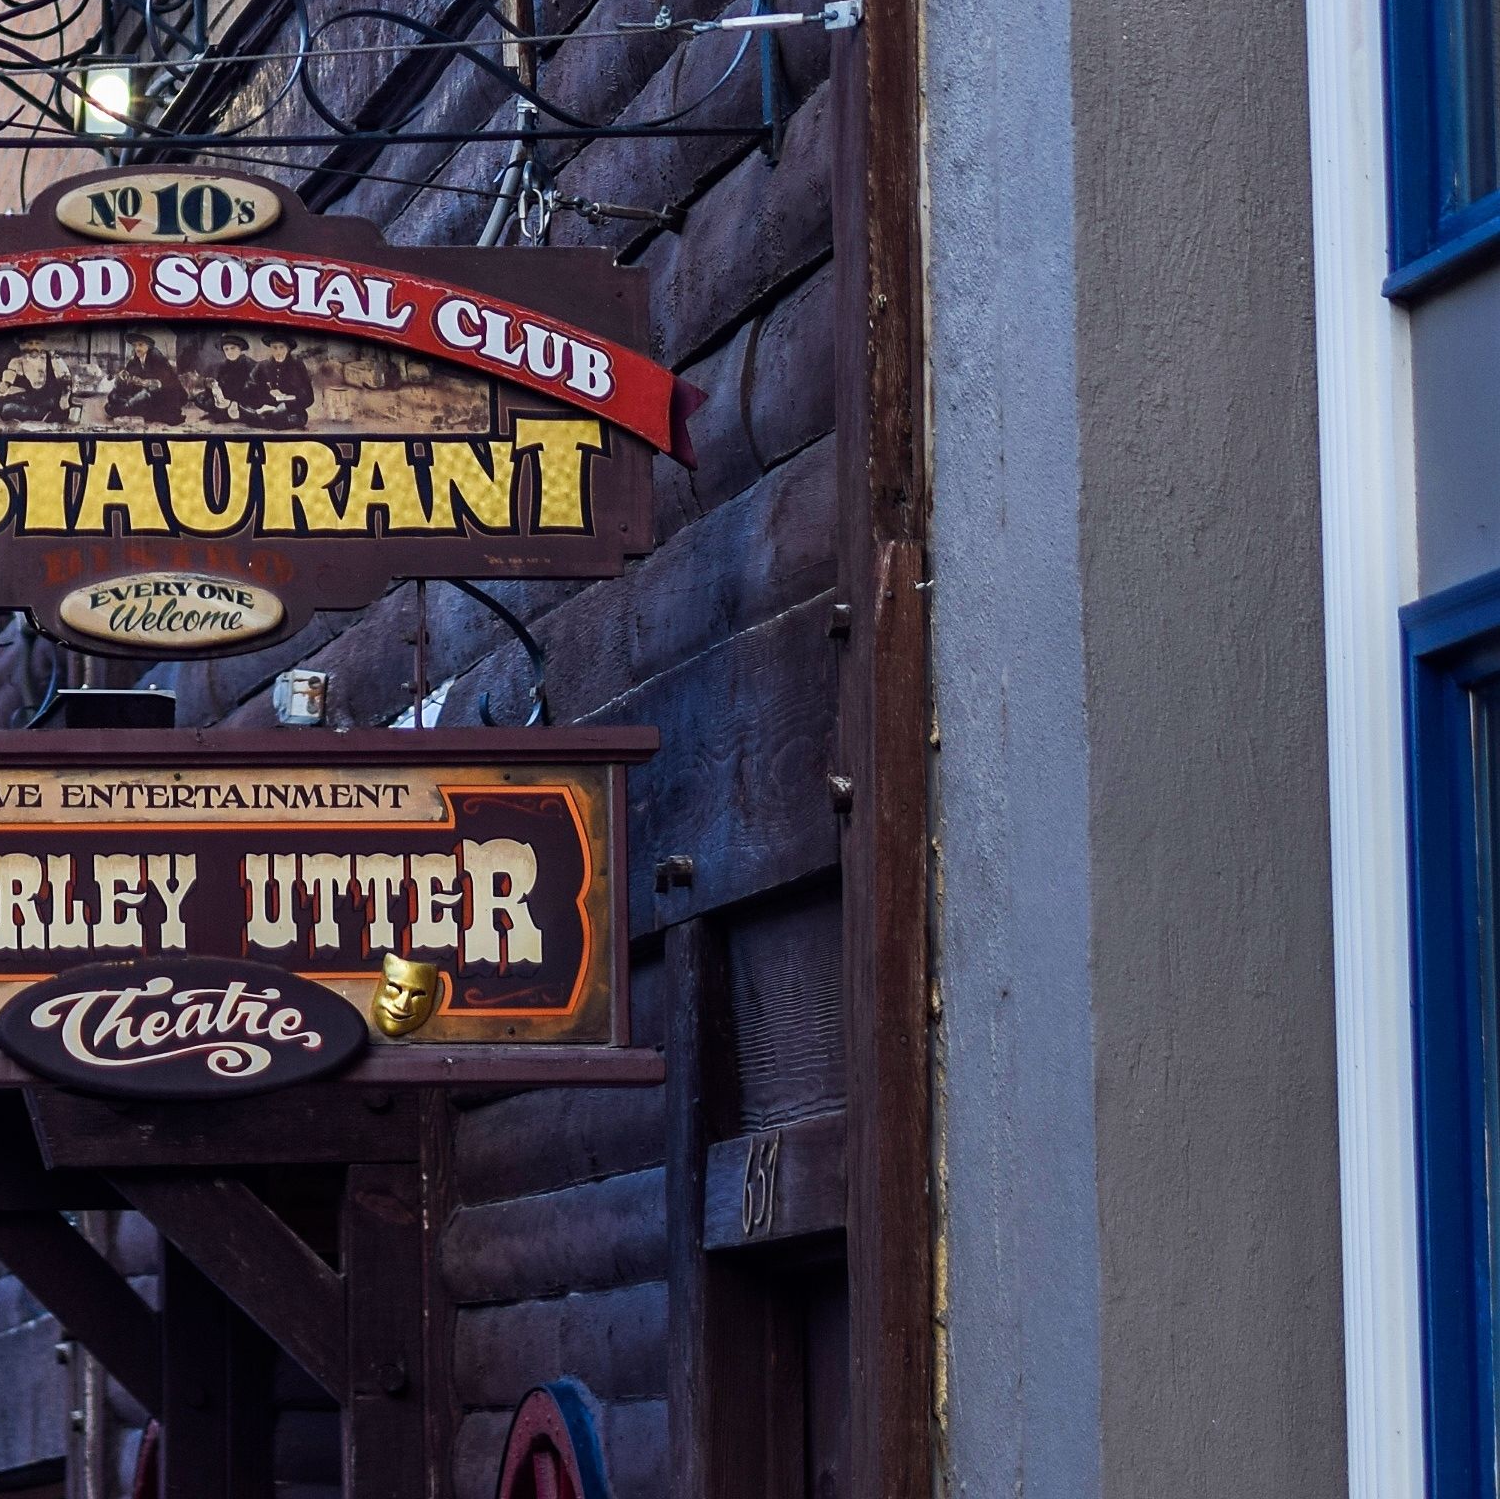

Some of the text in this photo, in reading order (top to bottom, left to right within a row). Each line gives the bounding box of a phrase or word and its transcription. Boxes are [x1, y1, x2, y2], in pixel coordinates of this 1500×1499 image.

[153, 256, 414, 330] SOCIAL
[436, 299, 613, 399] CLUB
[89, 581, 256, 610] EVERY ONE
[108, 597, 244, 632] Welcome
[60, 782, 410, 809] ENTERTAINMENT
[245, 838, 543, 965] UTTER
[28, 975, 323, 1078] Theatre
